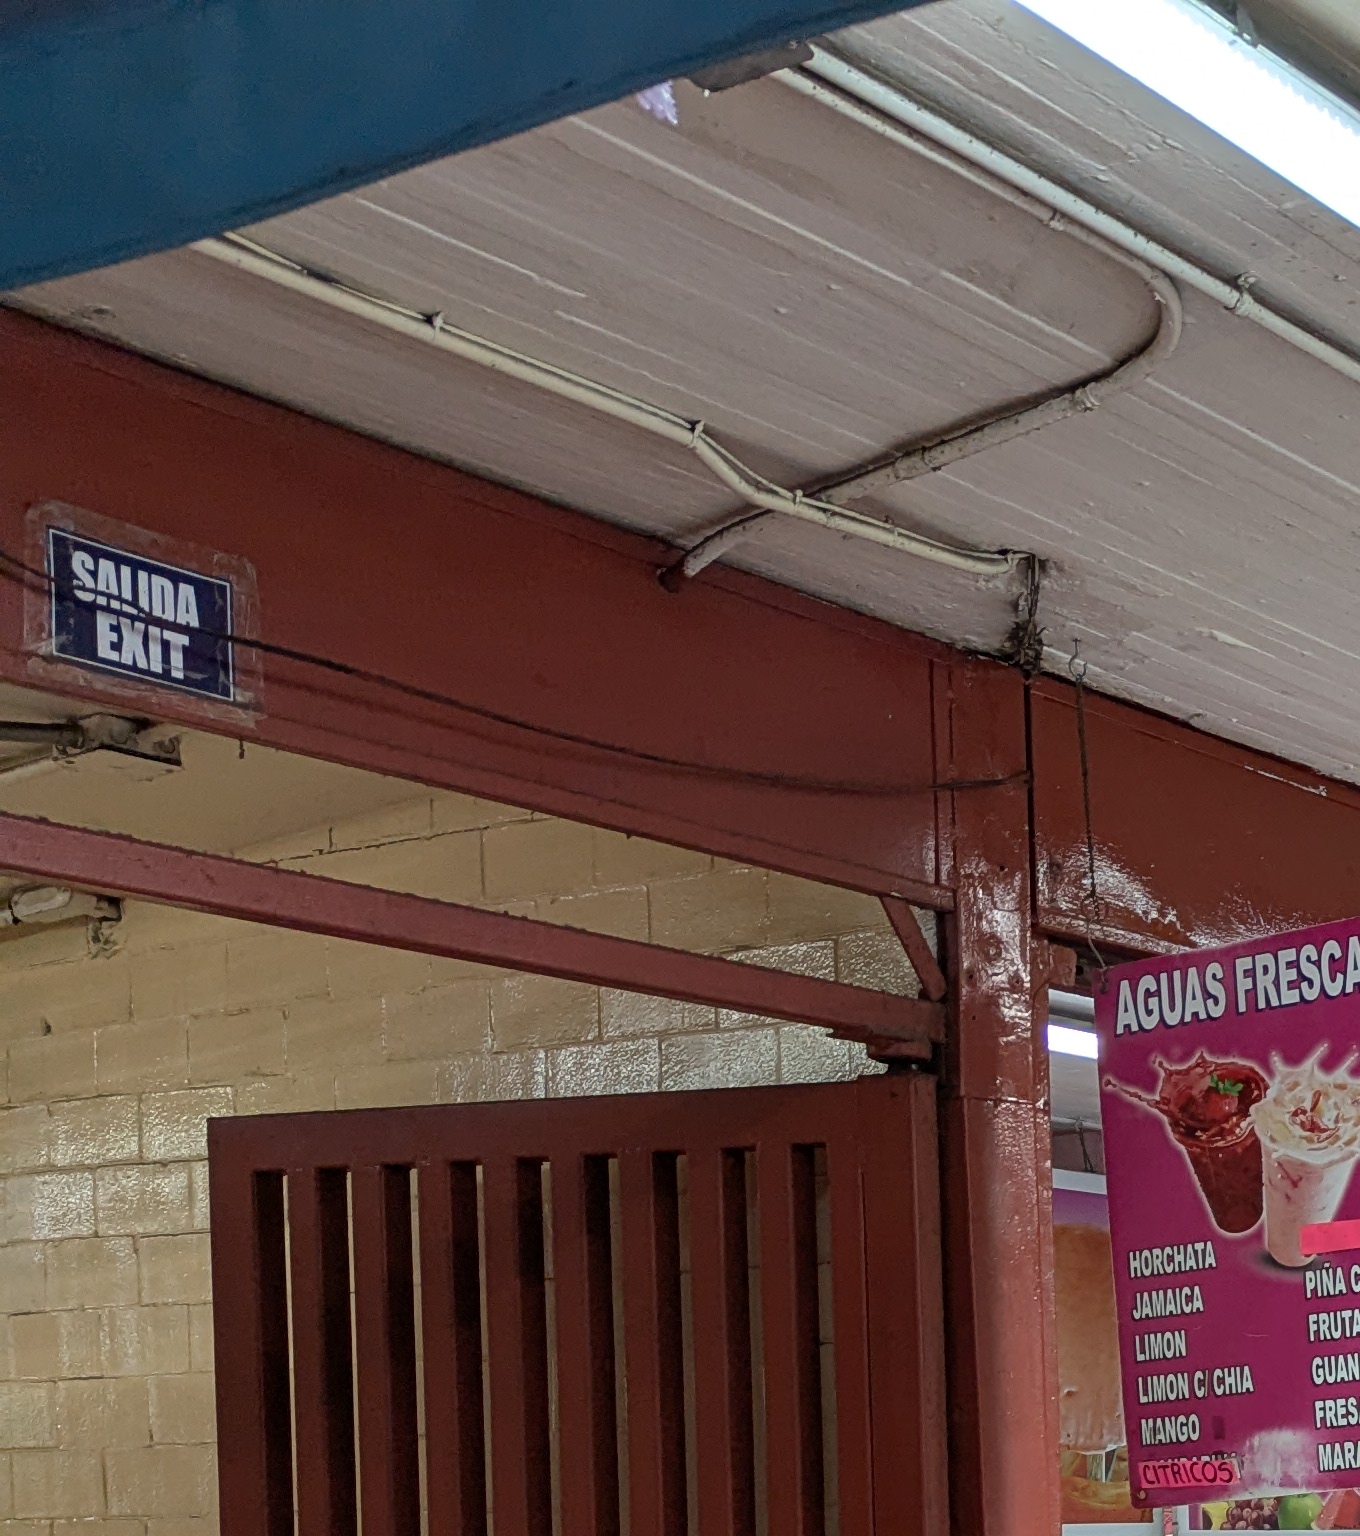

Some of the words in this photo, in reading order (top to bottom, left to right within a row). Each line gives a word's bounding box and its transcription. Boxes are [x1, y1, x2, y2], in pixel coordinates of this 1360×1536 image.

[71, 550, 199, 628] SALIDA
[96, 609, 189, 680] EXIT
[1115, 961, 1226, 1035] AGUAS
[1129, 1241, 1217, 1279] HORCHATA
[1305, 1262, 1347, 1299] PIÑA
[1132, 1286, 1205, 1320] JAMAICA
[1135, 1330, 1187, 1362] LIMON
[1138, 1373, 1190, 1404] LIMON
[1194, 1370, 1209, 1398] C/
[1212, 1366, 1255, 1396] CHIA
[1141, 1414, 1200, 1446] MANGO
[1142, 1461, 1235, 1487] CITRICOS
